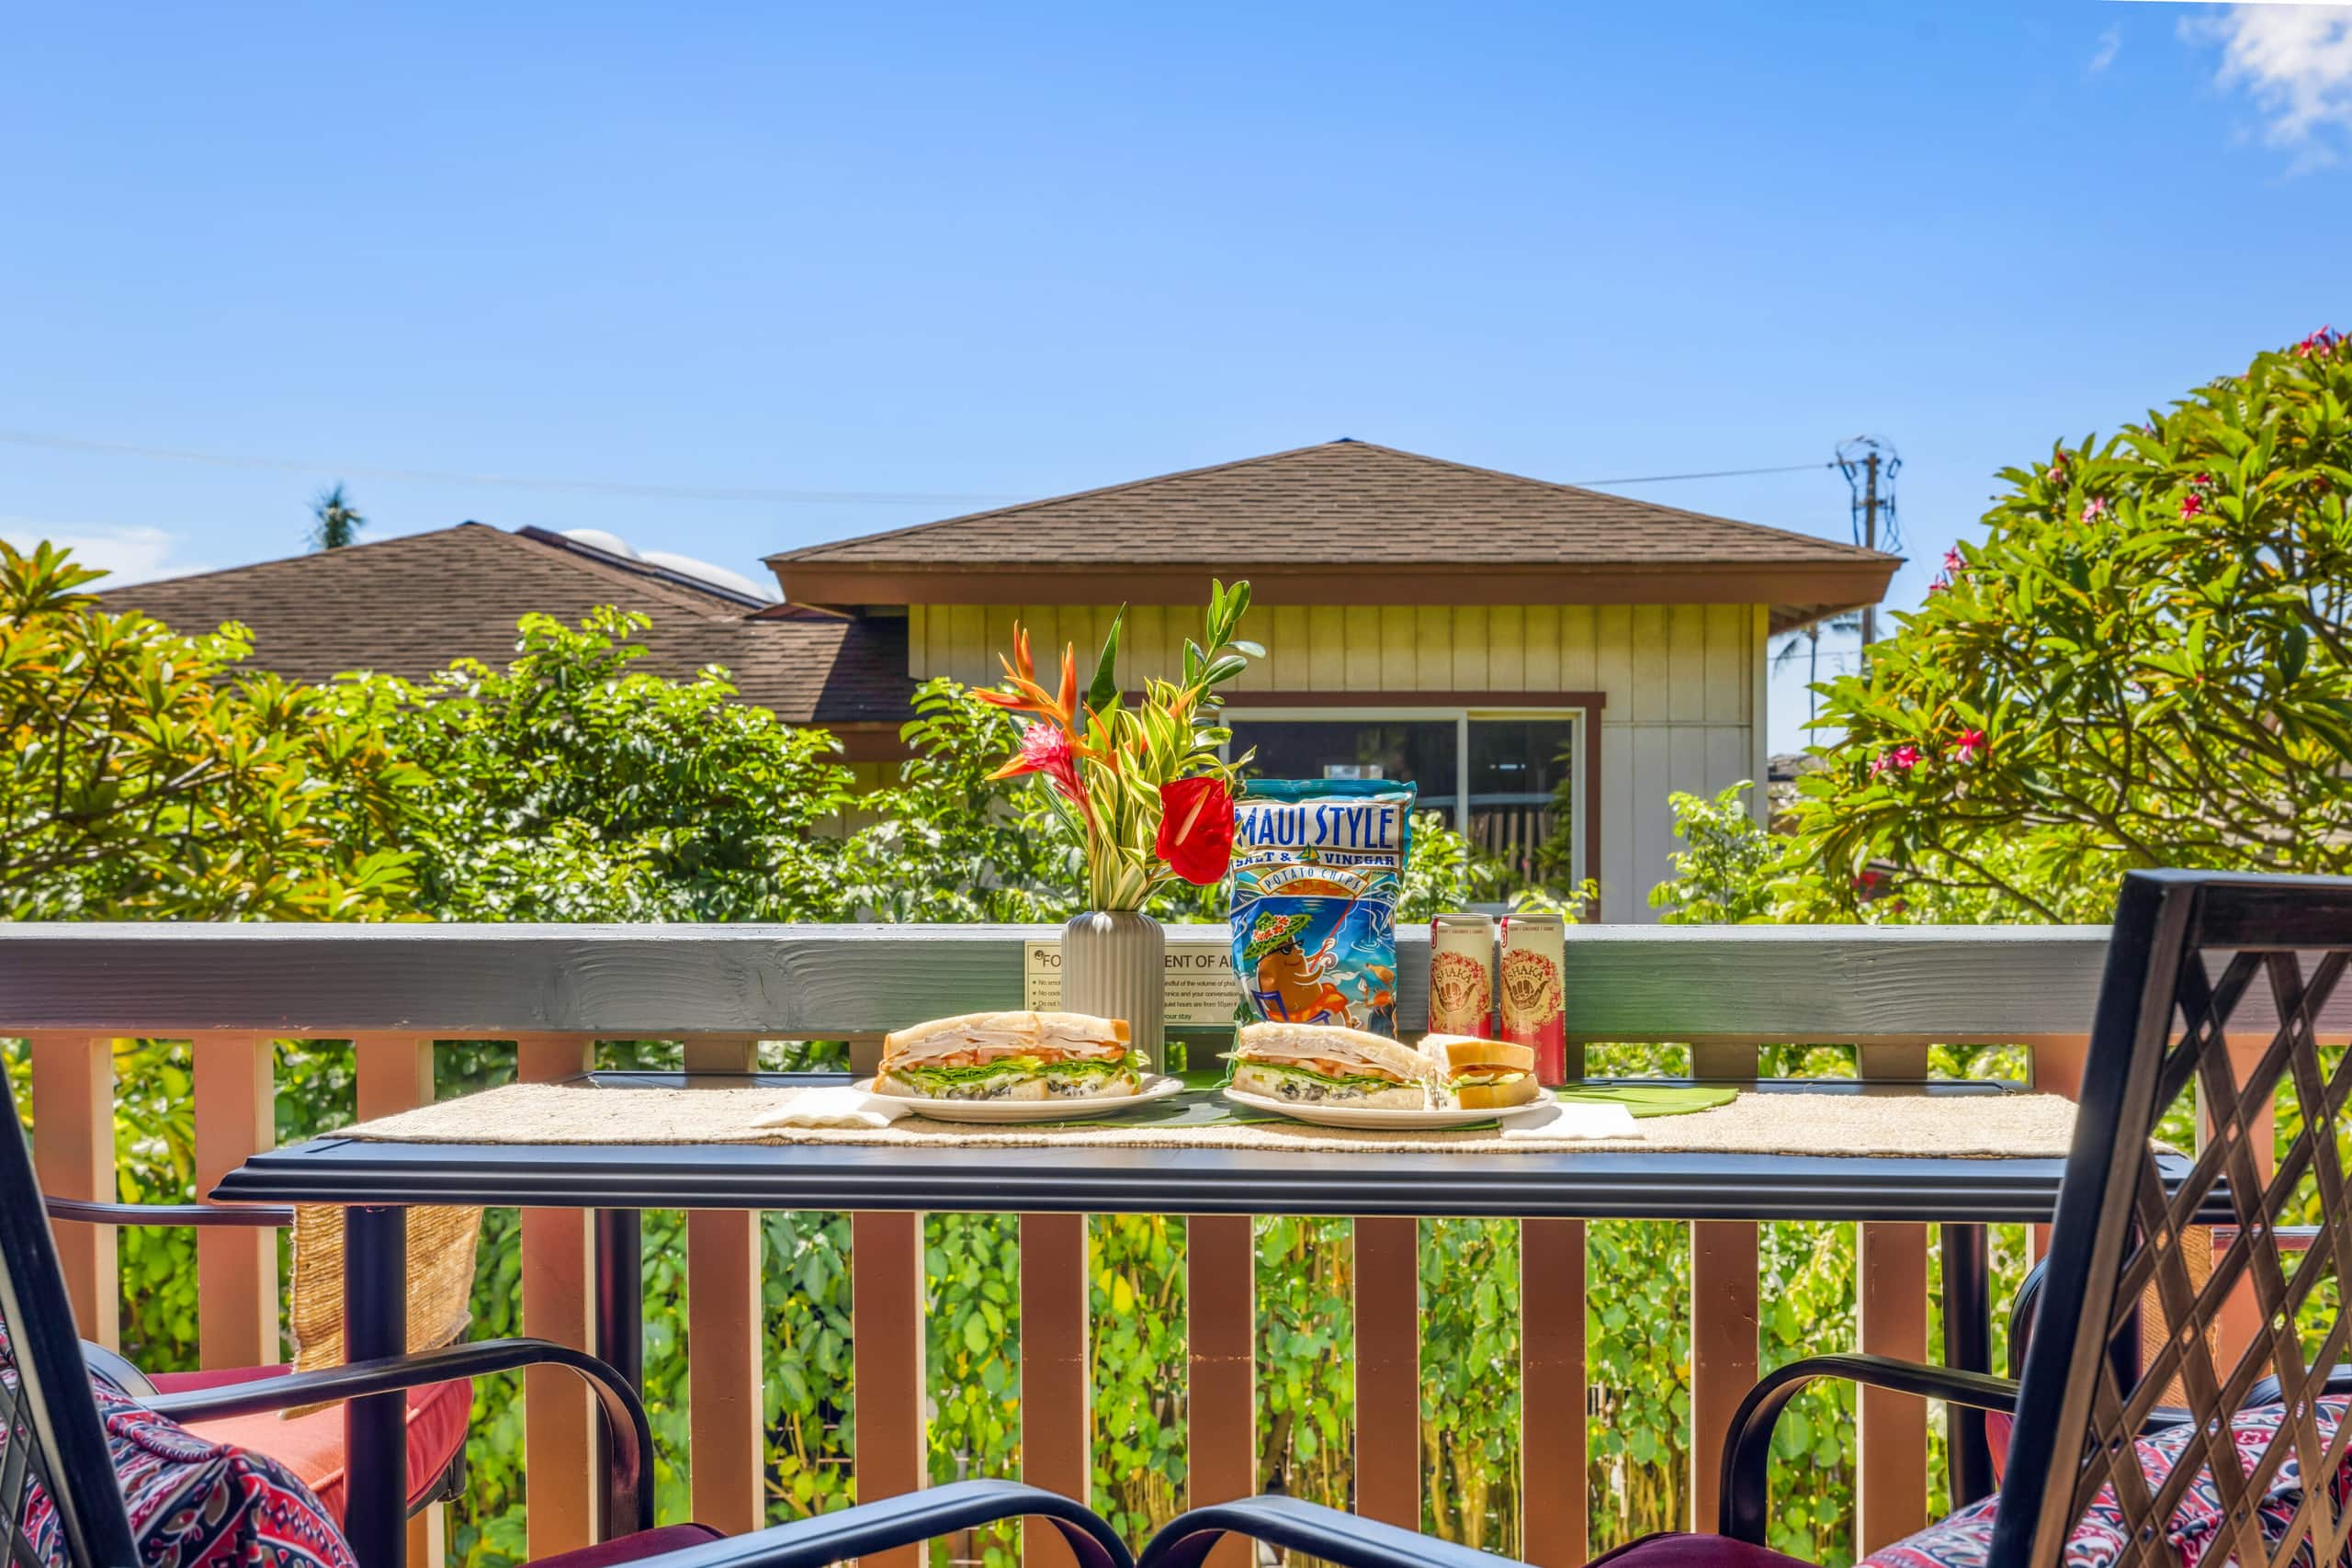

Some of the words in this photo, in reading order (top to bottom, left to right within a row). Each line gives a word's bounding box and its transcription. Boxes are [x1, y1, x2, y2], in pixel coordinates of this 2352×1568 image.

[1235, 807, 1305, 847] MAUI
[1315, 805, 1394, 849] STYLE
[1280, 852, 1292, 862] &
[1325, 852, 1395, 866] VINEGAR
[1264, 867, 1314, 890] POTATO
[1321, 868, 1362, 891] CHIPS
[1043, 954, 1062, 967] FO
[1195, 954, 1216, 967] OF
[1436, 967, 1472, 983] SHAKA
[1508, 965, 1544, 981] SHAKA
